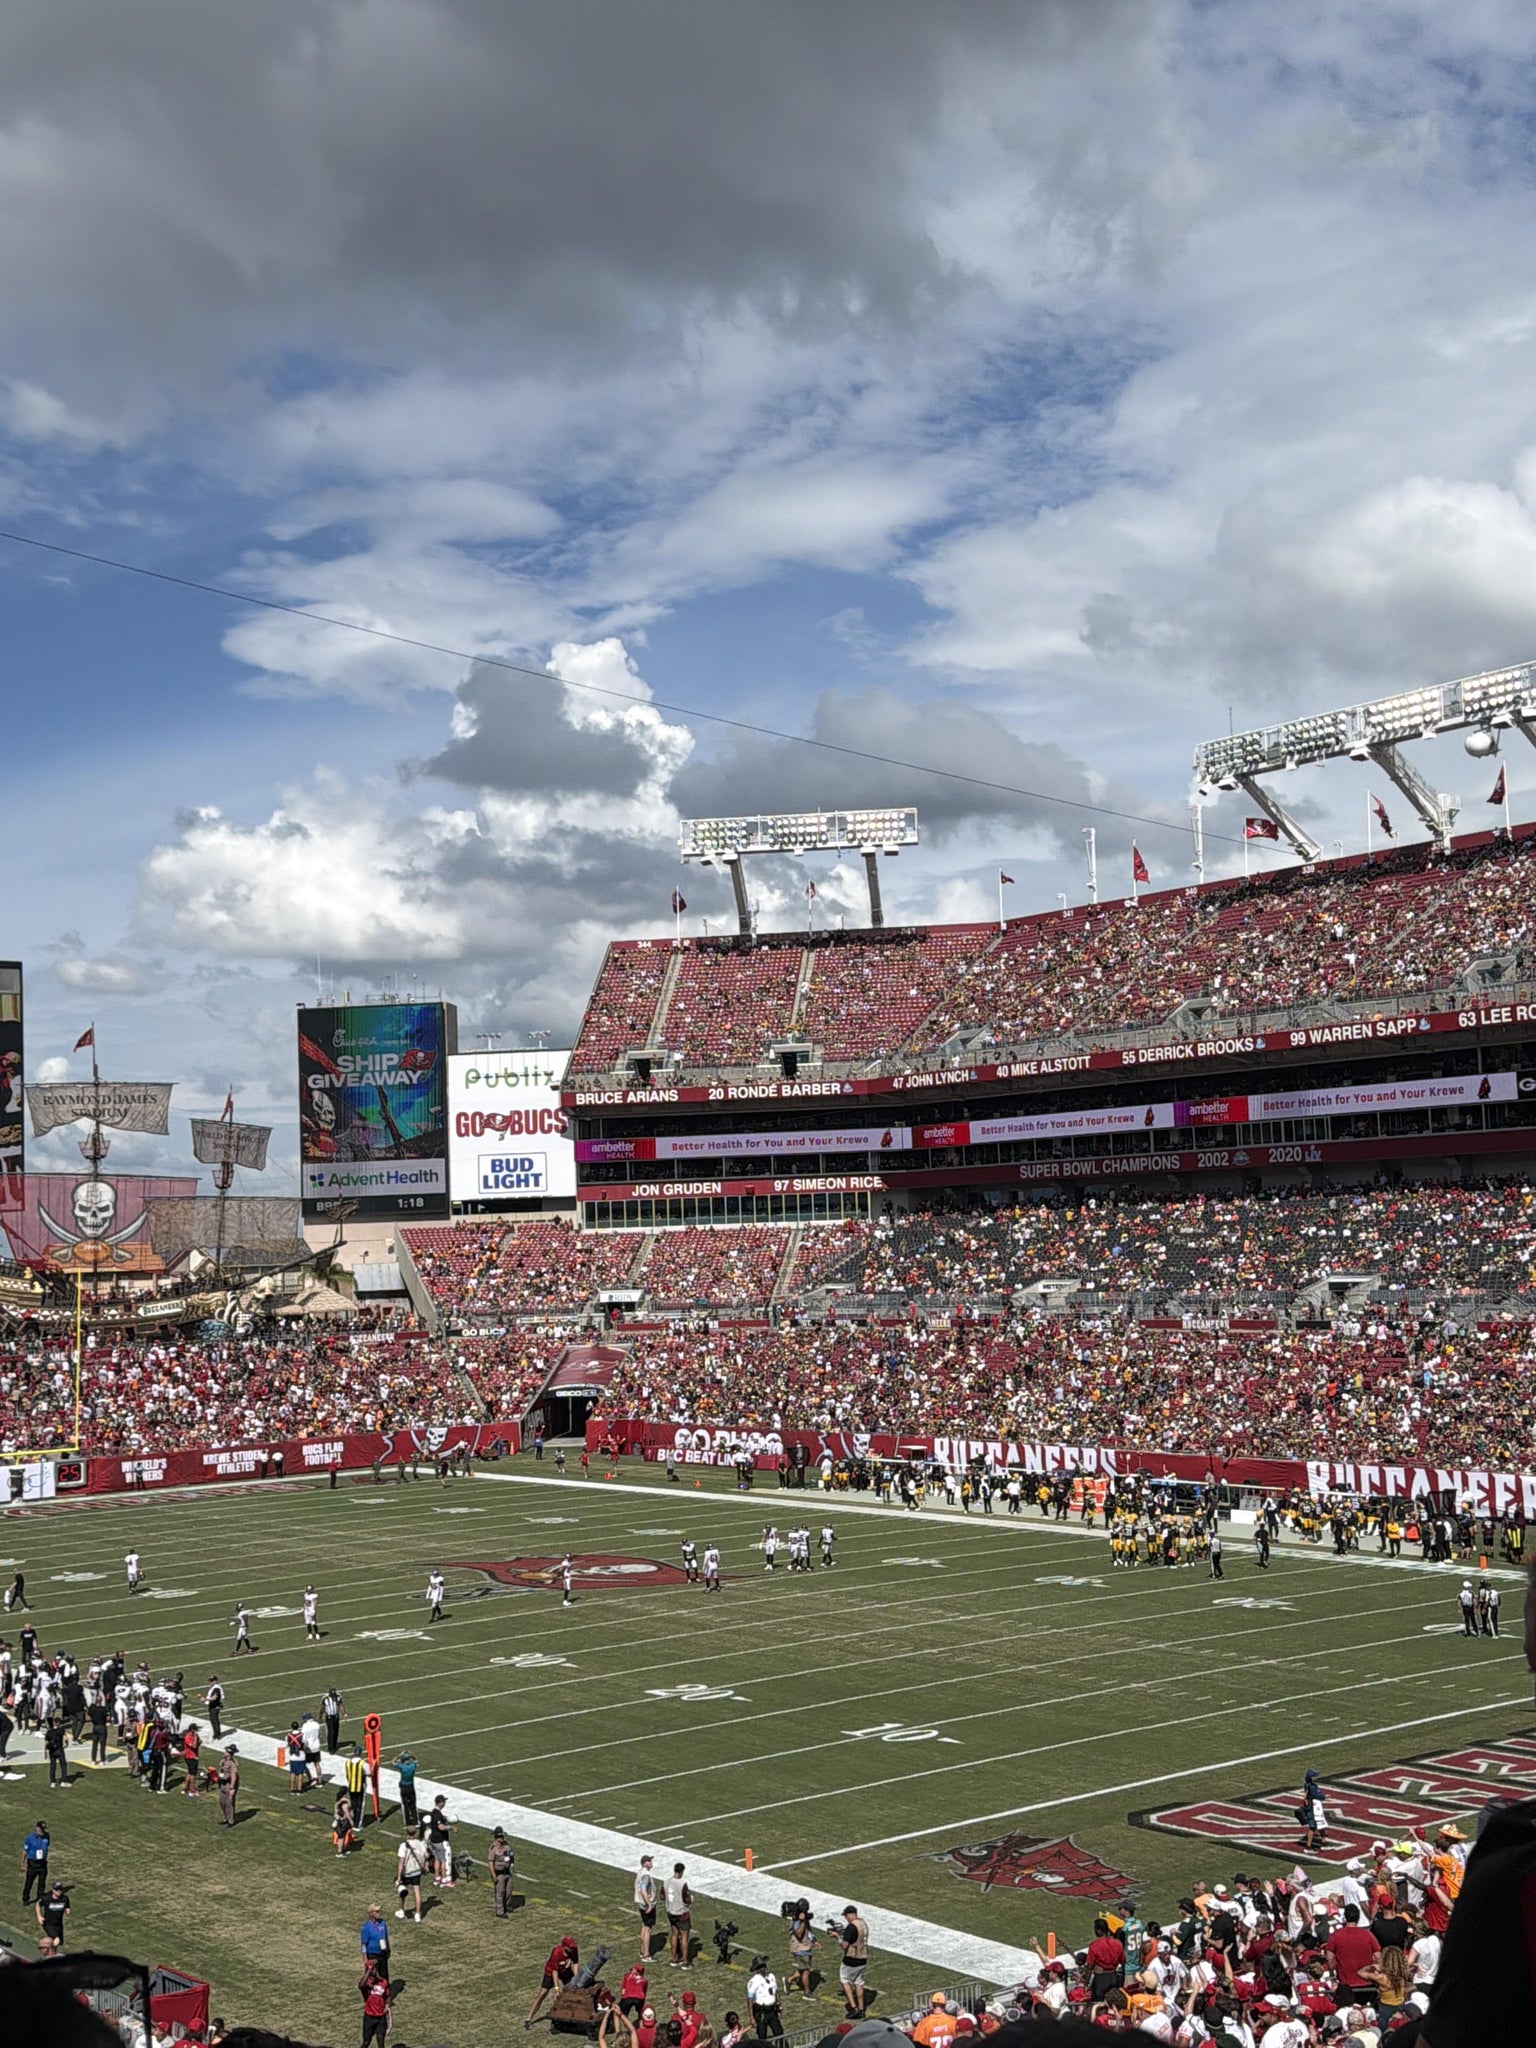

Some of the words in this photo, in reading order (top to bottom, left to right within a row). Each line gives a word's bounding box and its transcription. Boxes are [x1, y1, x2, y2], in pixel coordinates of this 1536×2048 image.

[1458, 1012, 1476, 1027] 63
[1480, 1007, 1512, 1024] LEE
[1290, 1032, 1306, 1046] 99
[1309, 1024, 1372, 1044] WARREN
[1376, 1018, 1417, 1036] SAPP
[1122, 1051, 1135, 1064] 55
[1139, 1044, 1194, 1063] DERRICK
[1197, 1037, 1254, 1056] BROOKS
[337, 1054, 398, 1072] SHIP
[996, 1066, 1009, 1078] 40
[1011, 1061, 1038, 1076] MIKE
[1040, 1056, 1091, 1073] ALSTOTT
[307, 1070, 423, 1089] GIVEAWAY
[892, 1077, 904, 1089] 47
[906, 1073, 933, 1088] JOHN
[935, 1069, 969, 1084] LYNCH
[43, 1094, 111, 1106] RAYMOND
[114, 1093, 158, 1105] JAMES
[576, 1091, 623, 1105] BRUCE
[627, 1089, 679, 1103] ARIANS
[708, 1088, 724, 1100] 20
[728, 1085, 777, 1099] RONDÉ
[782, 1083, 841, 1096] BARBER
[1263, 1098, 1294, 1111] Better
[1298, 1094, 1332, 1108] Health
[1335, 1093, 1351, 1104] for
[1354, 1093, 1373, 1104] You
[1376, 1090, 1396, 1101] and
[1400, 1088, 1426, 1099] Your
[1429, 1086, 1465, 1097] Krewe
[71, 1107, 129, 1118] STADIUM
[1189, 1102, 1229, 1116] ambetter
[456, 1111, 485, 1137] GO
[510, 1108, 568, 1136] BUCS
[981, 1126, 1006, 1135] Better
[1008, 1122, 1035, 1133] Health
[1036, 1120, 1049, 1130] for
[1050, 1120, 1066, 1129] You
[1068, 1117, 1084, 1127] and
[1086, 1116, 1105, 1126] Your
[1107, 1114, 1135, 1124] Krewe
[1203, 1114, 1229, 1122] HEALTH
[923, 1126, 956, 1139] ambetter
[591, 1141, 636, 1153] ambetter
[671, 1142, 704, 1151] Better
[708, 1139, 743, 1150] Health
[745, 1138, 761, 1148] for
[763, 1138, 783, 1147] You
[786, 1137, 806, 1146] and
[809, 1136, 833, 1146] Your
[606, 1152, 635, 1160] HEALTH
[1020, 1164, 1060, 1179] SUPER
[1063, 1160, 1100, 1177] BOWL
[1102, 1154, 1180, 1174] CHAMPIONS
[1197, 1151, 1229, 1168] 2002
[1268, 1147, 1301, 1163] 2020
[491, 1158, 534, 1173] BUD
[483, 1173, 543, 1189] LIGHT
[774, 1179, 789, 1192] 97
[793, 1177, 847, 1191] SIMEON
[850, 1176, 883, 1189] RICE
[632, 1184, 660, 1197] JON
[663, 1182, 721, 1196] GRUDEN
[398, 1198, 424, 1208] 1:18
[462, 1329, 476, 1337] GO
[478, 1328, 506, 1336] BUCS
[302, 1443, 324, 1455] BUCS
[325, 1442, 344, 1453] FLAG
[203, 1453, 230, 1465] KREWE
[232, 1449, 263, 1462] STUDEN
[685, 1450, 716, 1465] BEAT
[717, 1454, 736, 1466] LIN
[60, 1465, 79, 1482] 25
[216, 1461, 255, 1474] ATHLETES
[645, 1684, 735, 1700] 20
[840, 1722, 940, 1742] 10
